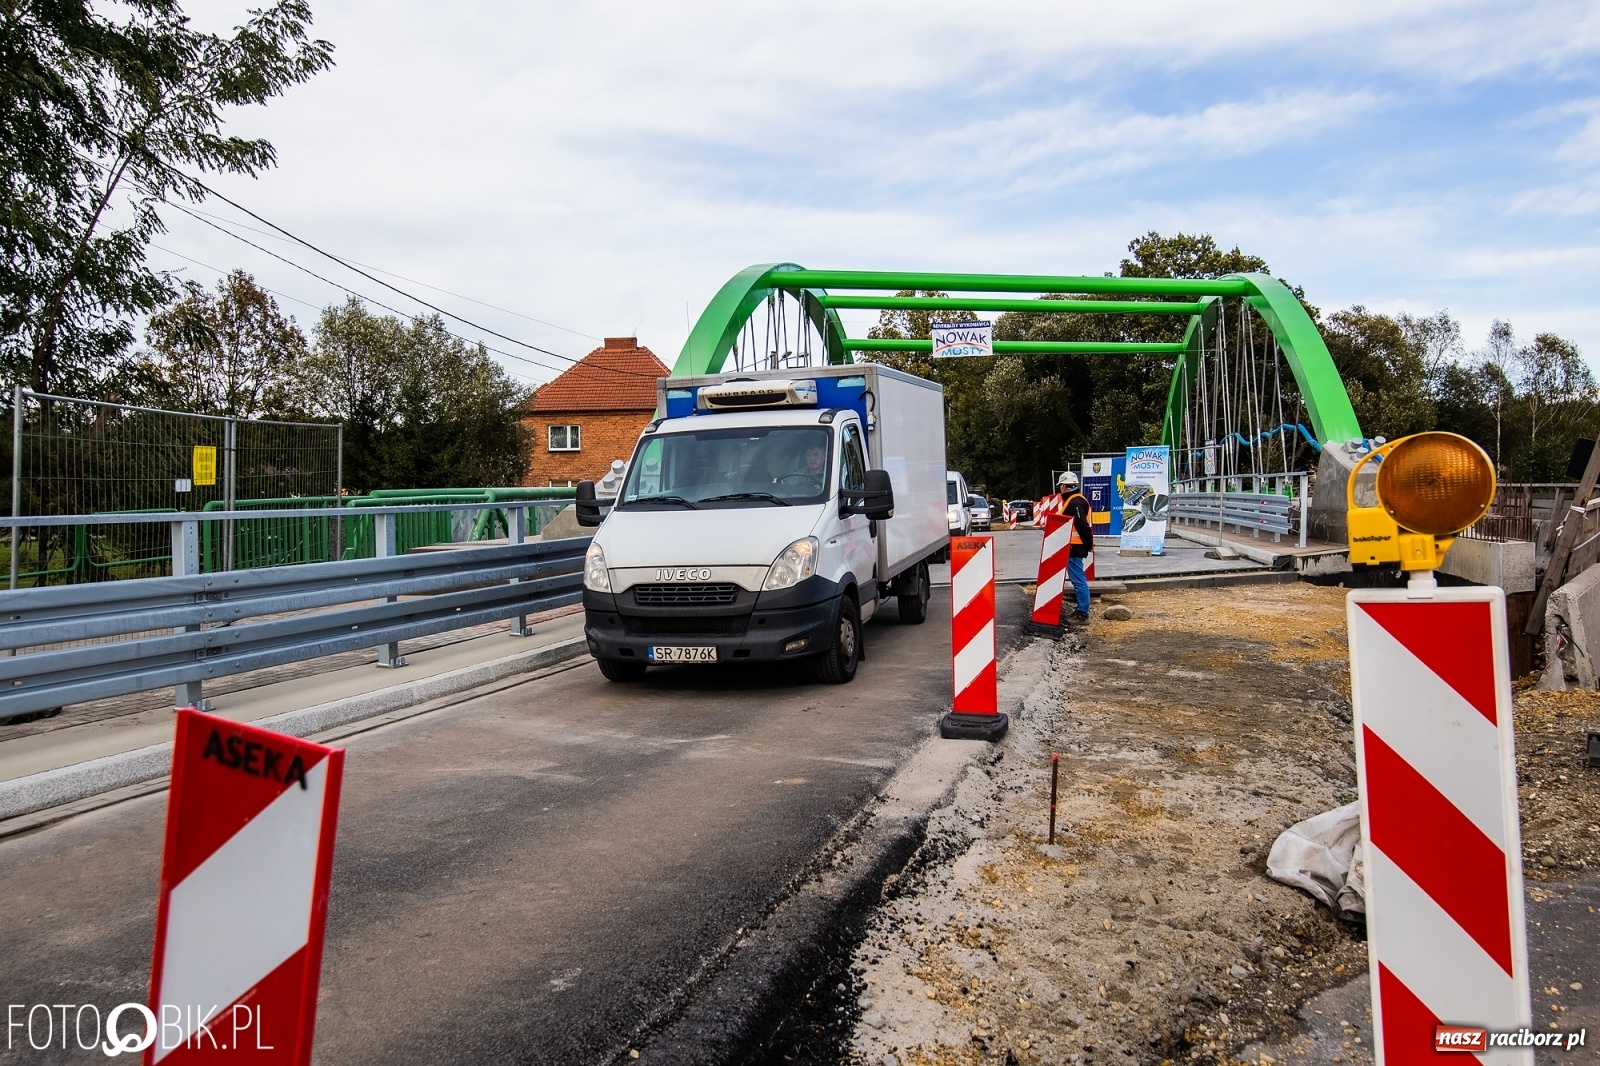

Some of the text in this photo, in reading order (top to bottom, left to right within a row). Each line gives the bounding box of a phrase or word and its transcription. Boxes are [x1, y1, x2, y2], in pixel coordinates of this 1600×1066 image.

[935, 331, 988, 348] NOWAK
[941, 346, 984, 356] MOSTY
[1131, 450, 1163, 463] NOWAK
[1133, 462, 1160, 470] MOSTY
[956, 541, 987, 550] ASEKA
[655, 568, 711, 581] IVECO
[655, 647, 673, 660] SR
[676, 647, 716, 660] 7876K
[203, 729, 308, 791] ASEKA
